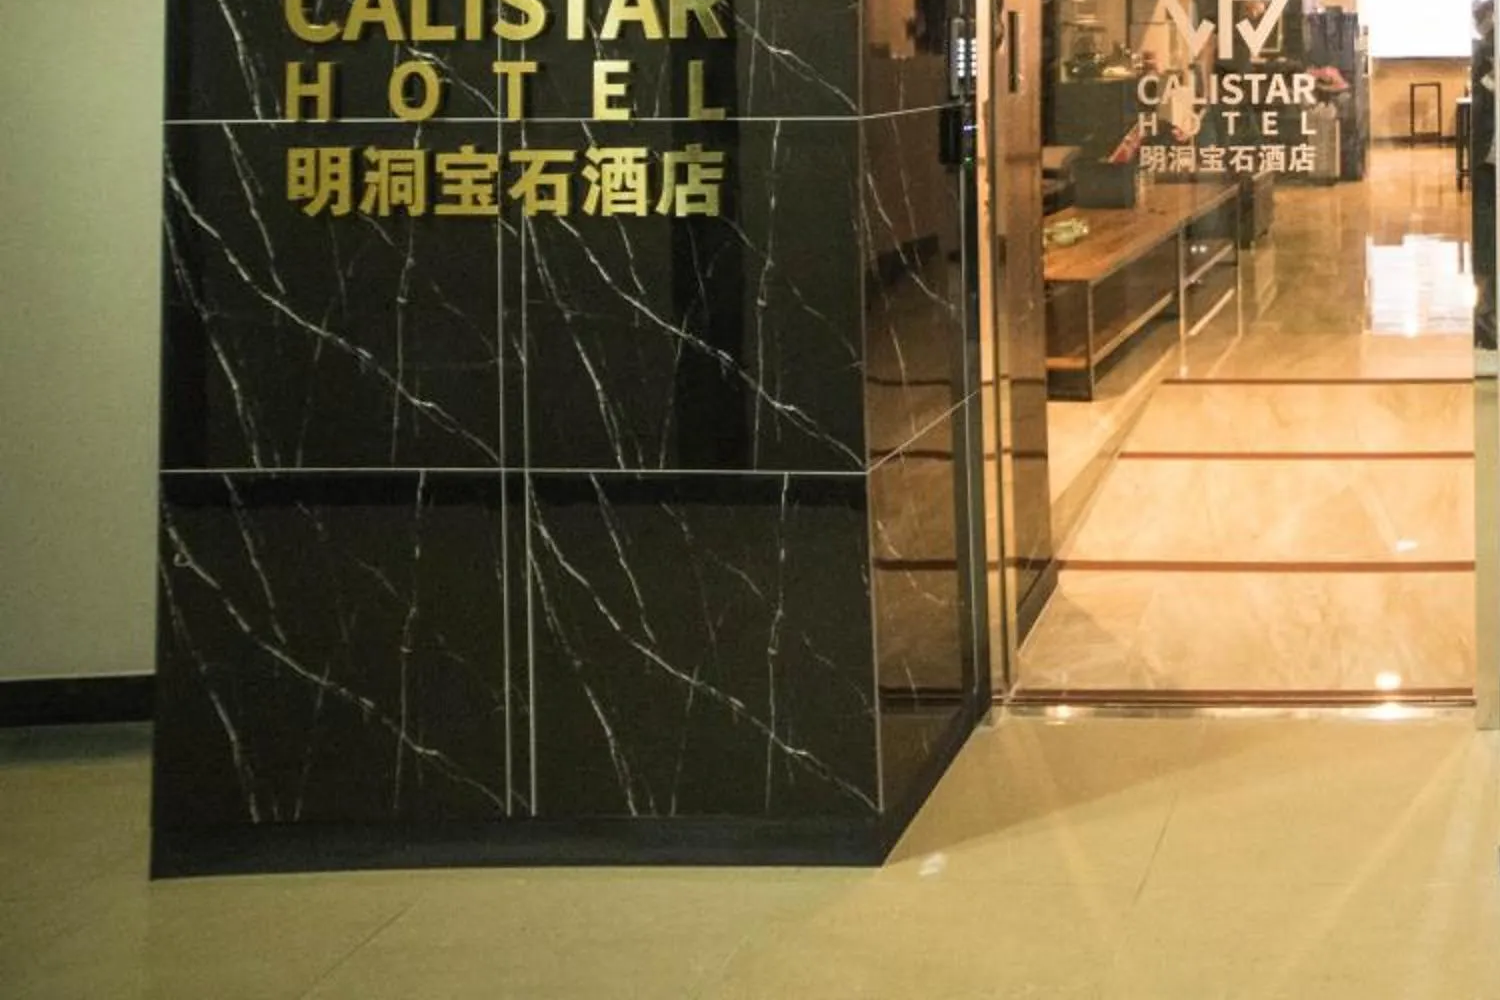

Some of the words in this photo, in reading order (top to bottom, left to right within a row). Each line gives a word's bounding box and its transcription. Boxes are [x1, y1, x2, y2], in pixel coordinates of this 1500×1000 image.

[285, 60, 726, 121] HOTEL
[1137, 73, 1317, 105] CALISTAR
[1139, 144, 1317, 173] 明洞宝石酒店
[286, 146, 724, 218] 明洞宝石酒店
